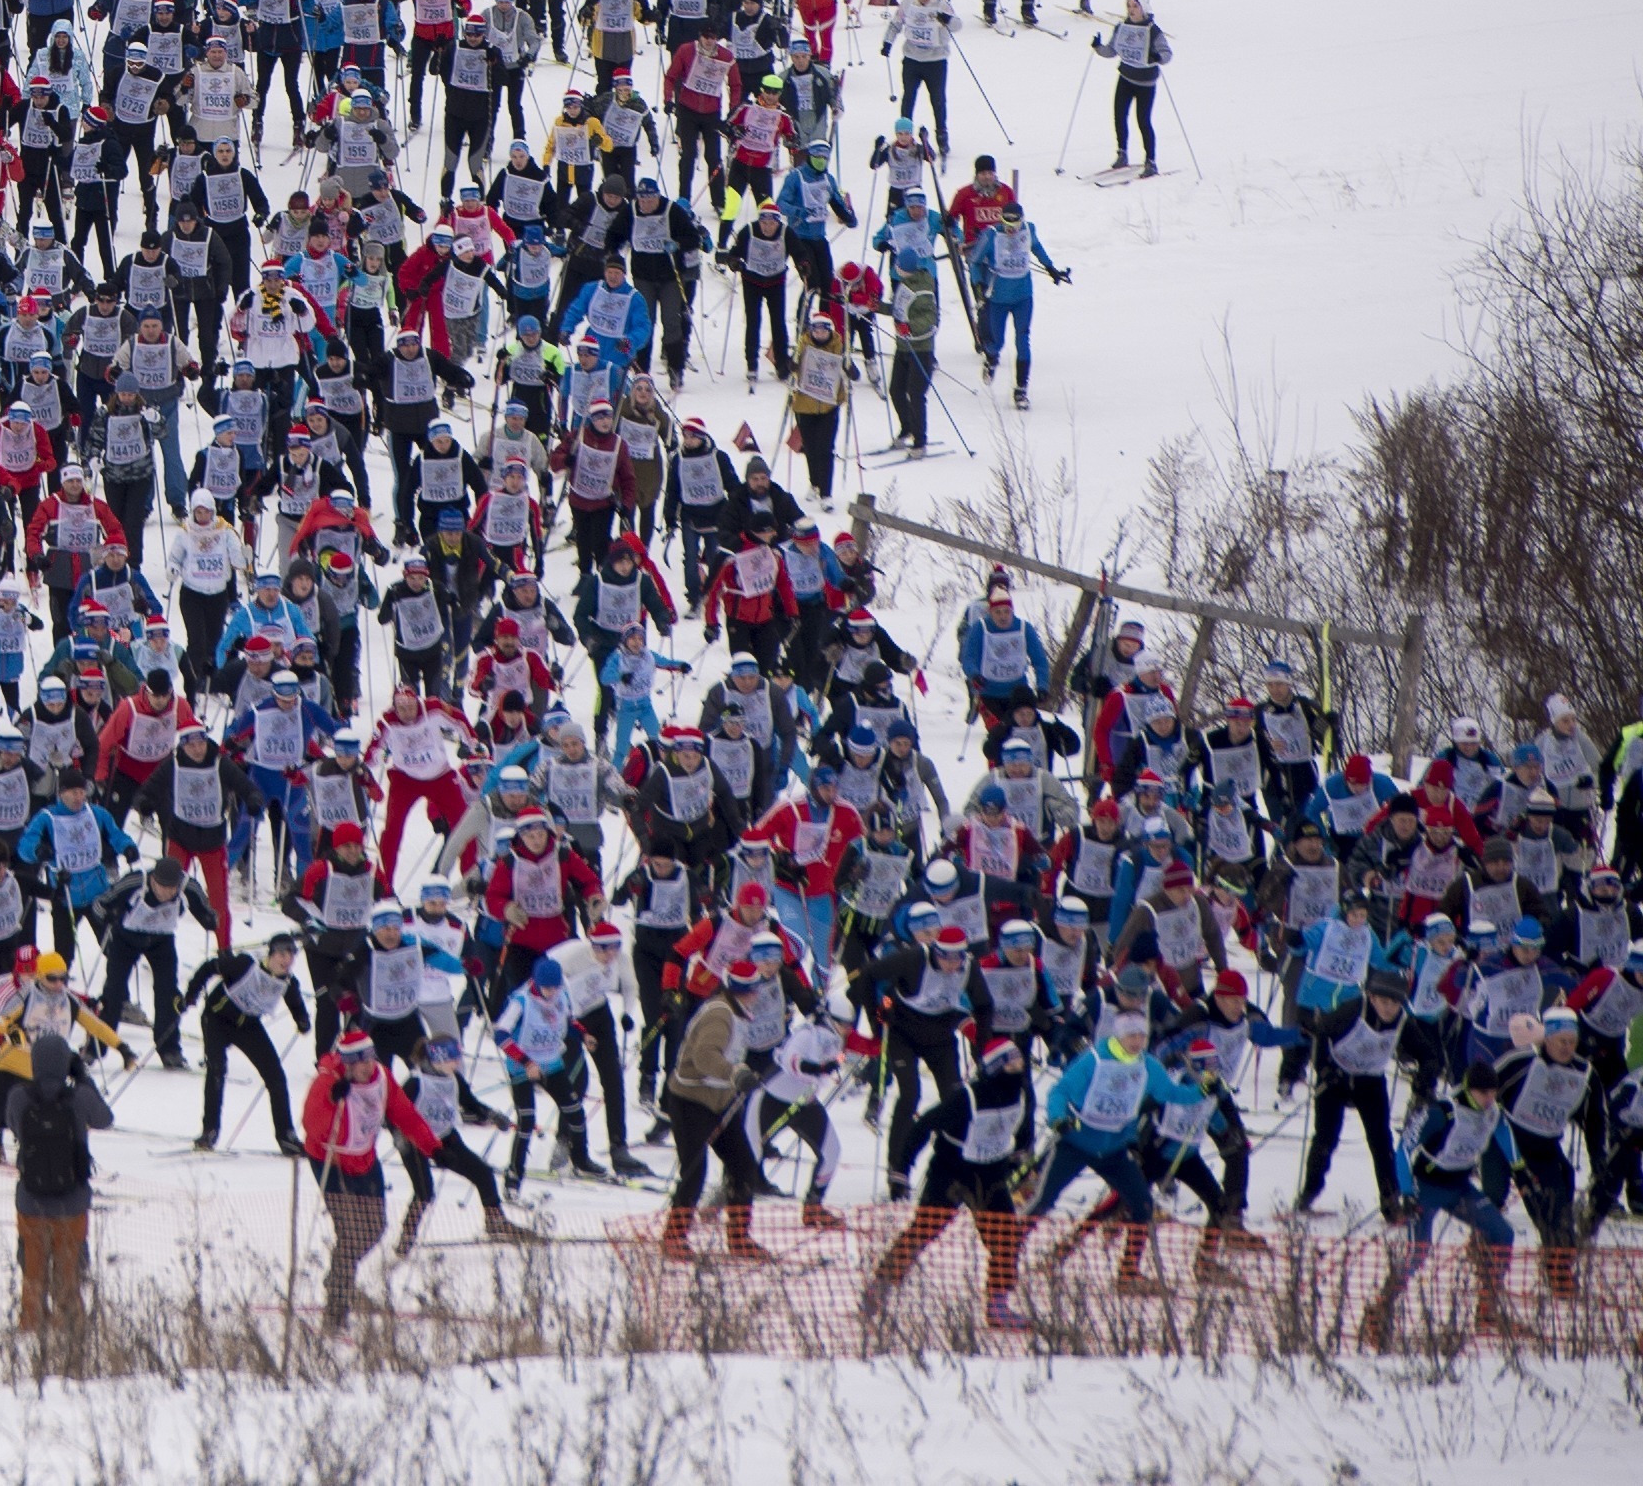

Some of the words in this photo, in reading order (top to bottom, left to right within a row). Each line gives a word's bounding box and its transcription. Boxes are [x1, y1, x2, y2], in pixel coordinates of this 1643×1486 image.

[122, 100, 144, 111] 6729
[205, 96, 231, 107] 13036
[348, 146, 367, 157] 1515
[31, 274, 56, 285] 6760
[140, 372, 164, 383] 7205
